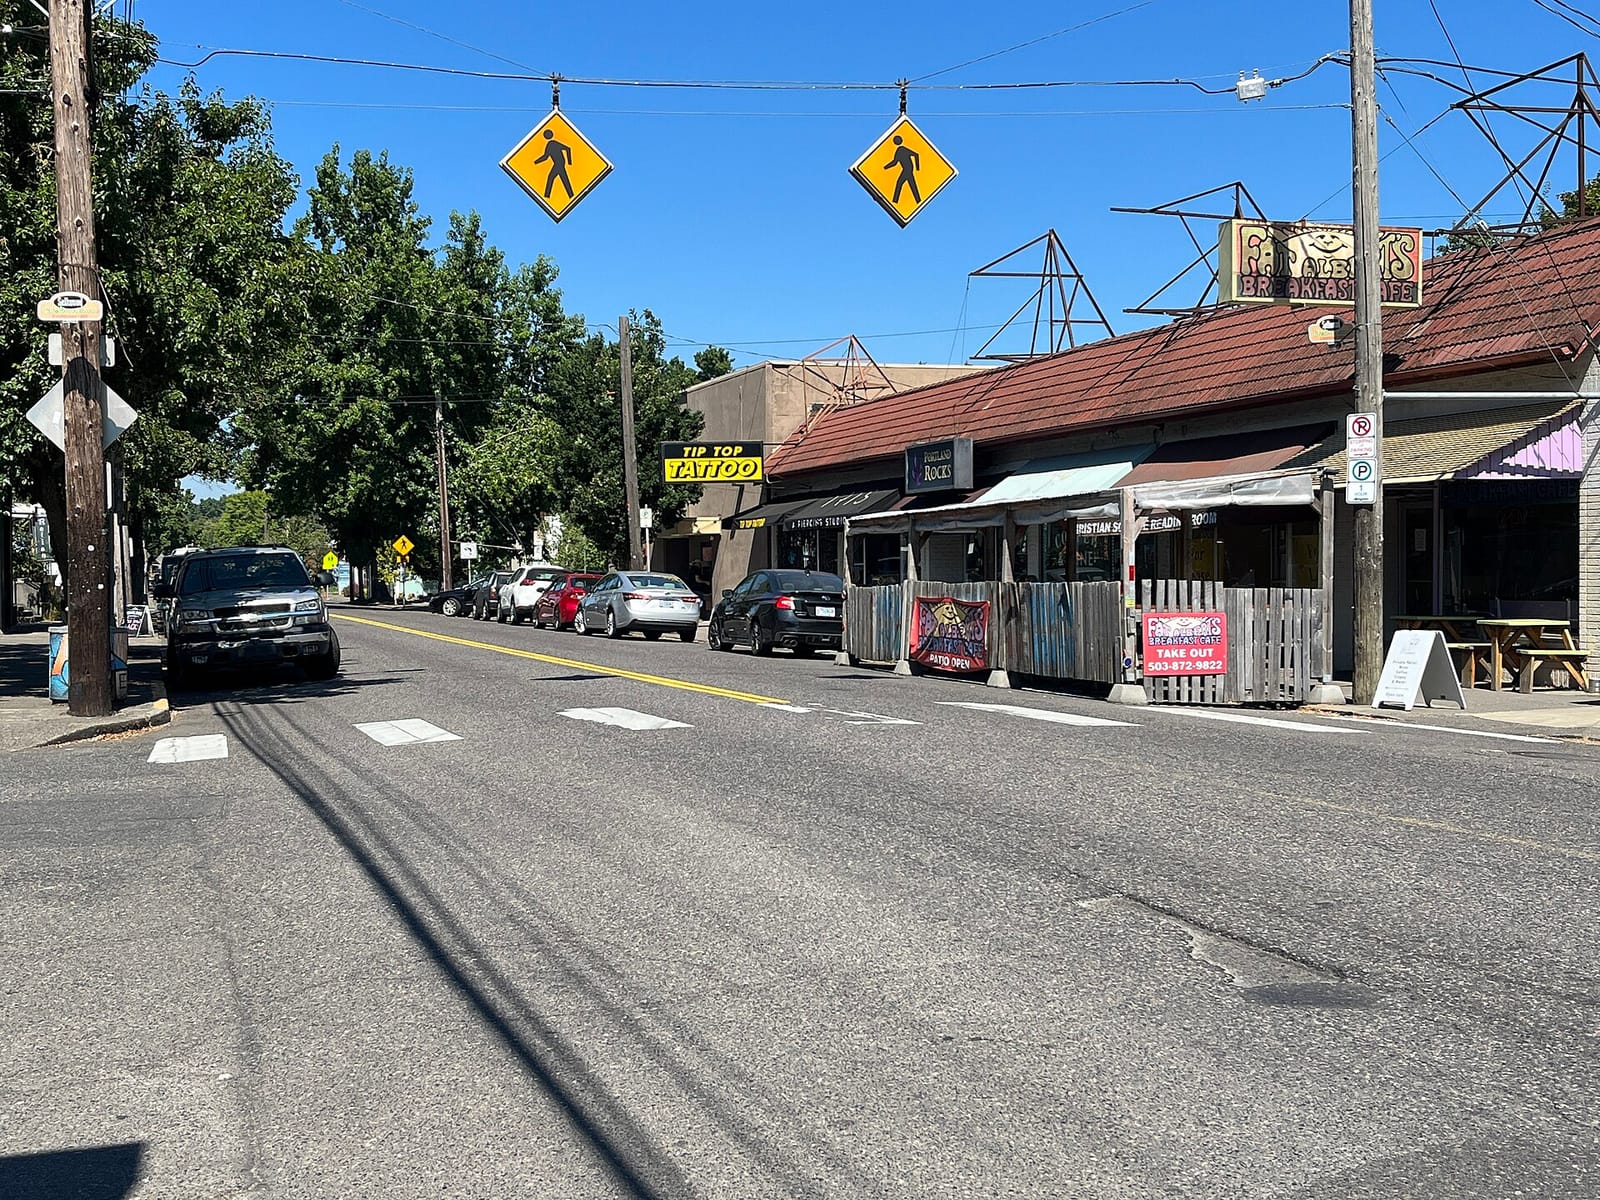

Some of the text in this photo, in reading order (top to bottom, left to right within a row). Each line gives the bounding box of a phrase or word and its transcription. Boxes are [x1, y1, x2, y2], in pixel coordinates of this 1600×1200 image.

[1240, 226, 1415, 280] FAT ALBT'S
[1379, 281, 1413, 302] AFE
[683, 445, 743, 458] TIP TOP
[924, 449, 952, 463] PORTLAND
[670, 459, 757, 478] TATTOO
[924, 464, 952, 481] ROCKS
[797, 518, 823, 528] PIERCING
[1150, 515, 1182, 530] READIN
[1148, 616, 1171, 637] FAT
[1149, 635, 1222, 646] BREAKFAST CAFE
[1156, 648, 1214, 658] TAKE OUT
[930, 653, 970, 669] PATIO OPEN
[1147, 660, 1223, 671] 503-872-9822
